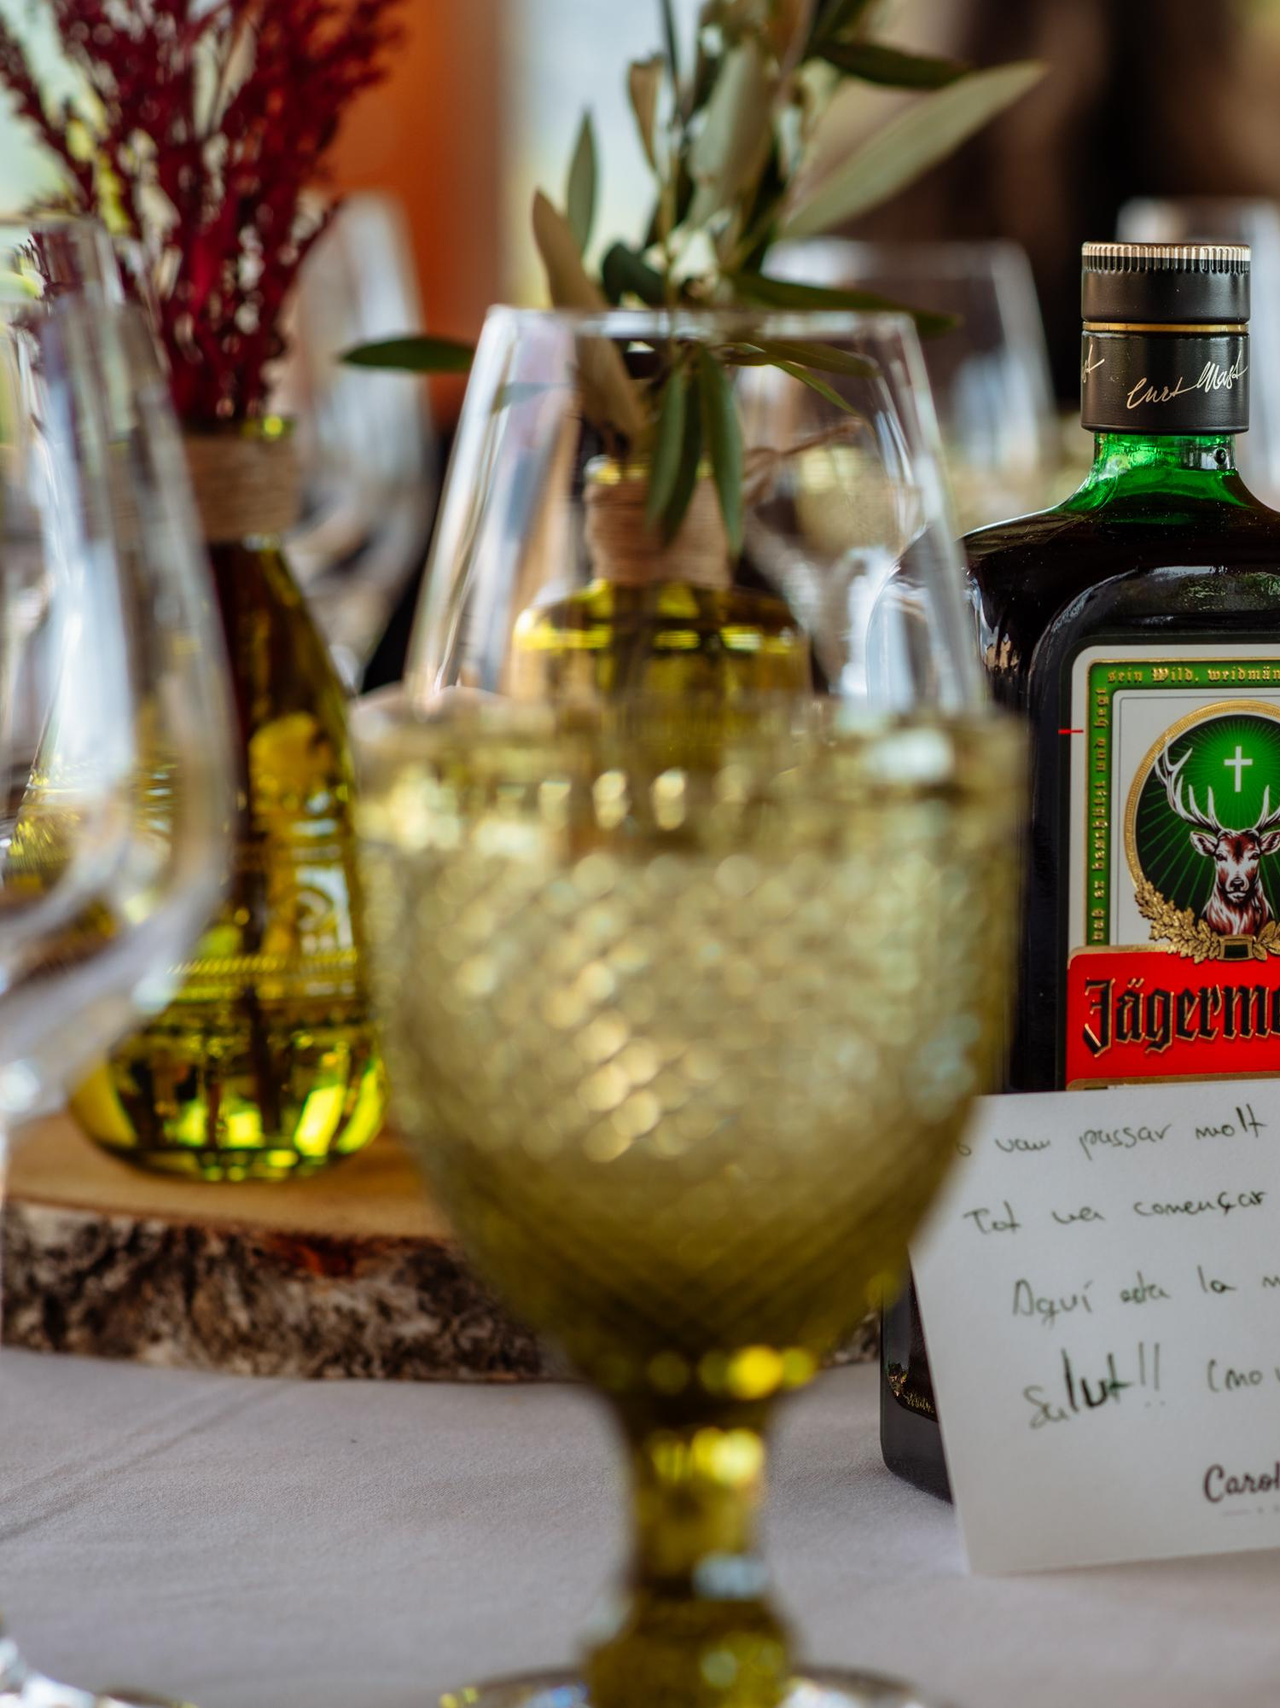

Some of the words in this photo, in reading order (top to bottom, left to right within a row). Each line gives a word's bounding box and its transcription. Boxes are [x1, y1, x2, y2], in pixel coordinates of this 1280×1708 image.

[1107, 667, 1143, 682] sein
[1078, 1123, 1173, 1161] passar
[1195, 1103, 1268, 1140] molt
[963, 1200, 1022, 1234] Tot
[1012, 1278, 1094, 1328] Aquí
[1197, 1265, 1237, 1294] la
